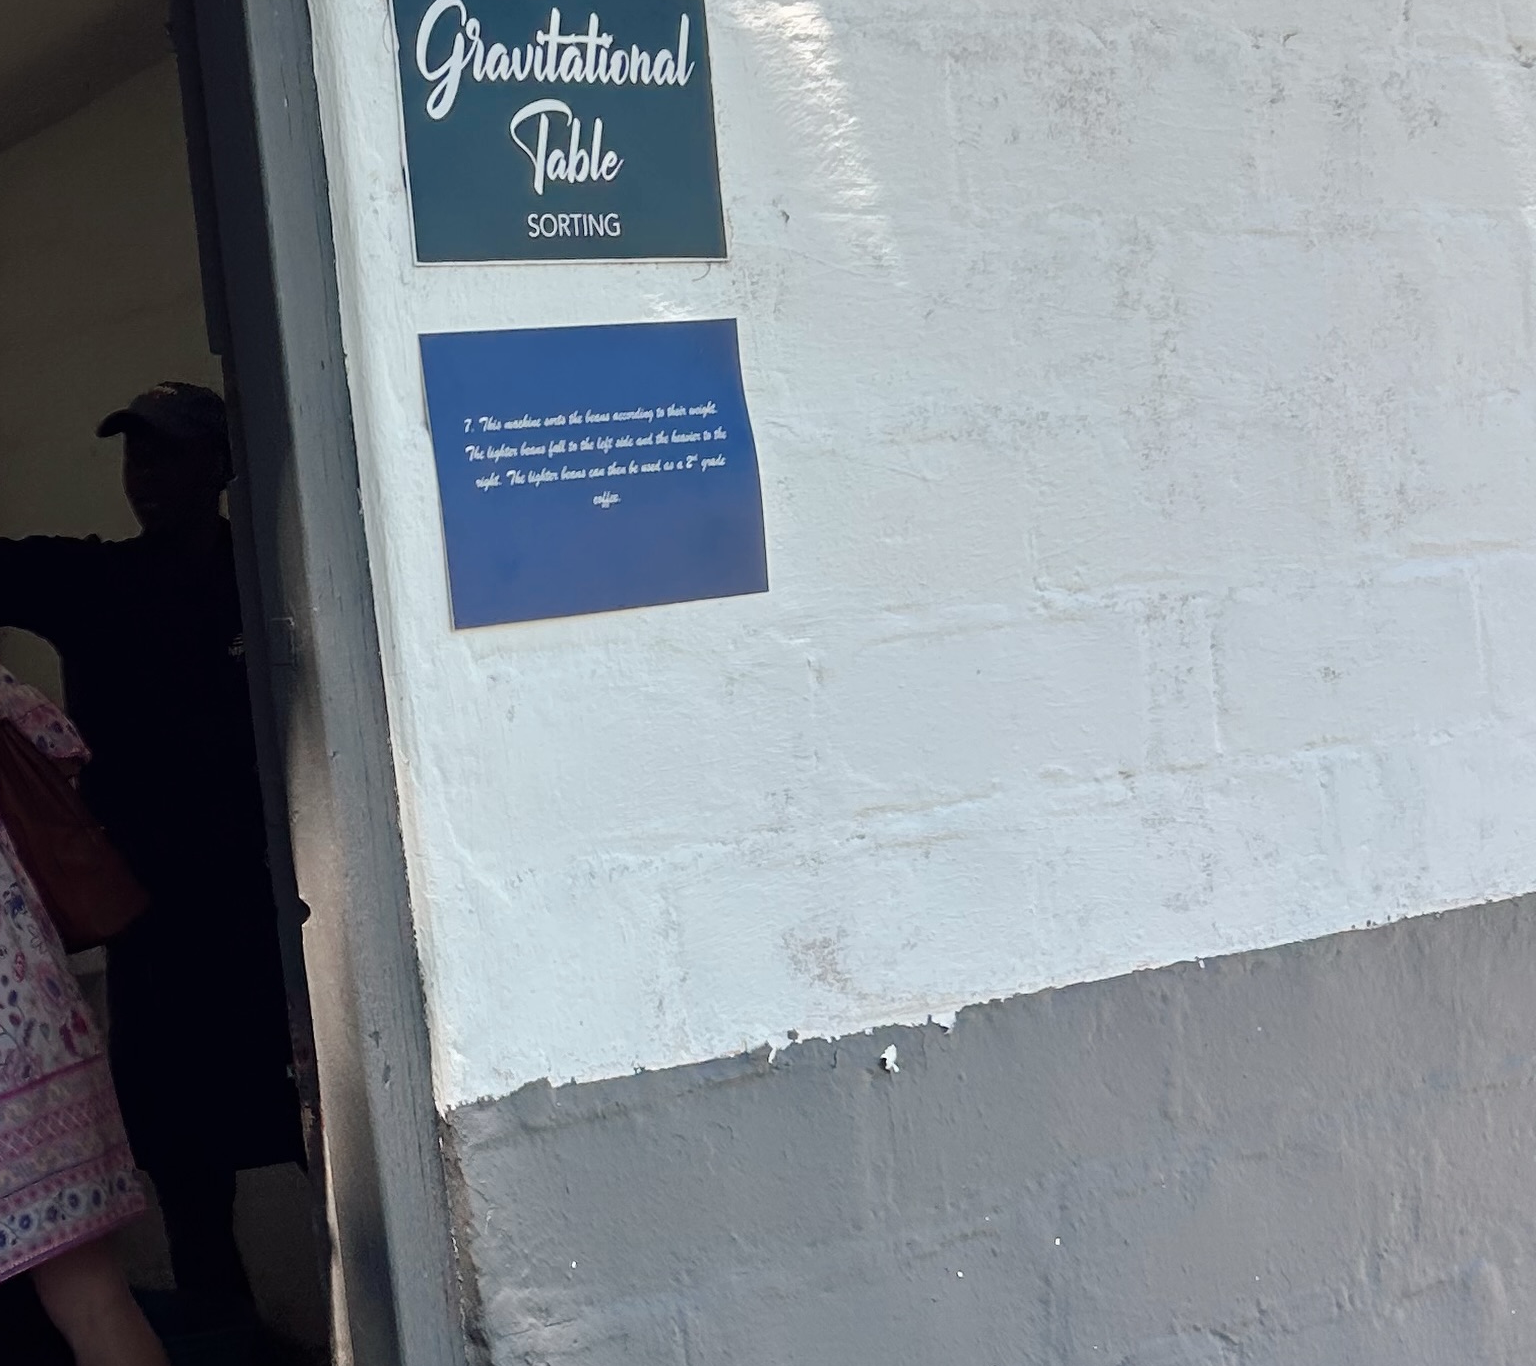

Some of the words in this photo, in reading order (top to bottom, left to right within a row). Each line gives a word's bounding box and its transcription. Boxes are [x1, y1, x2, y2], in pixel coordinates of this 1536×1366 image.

[510, 99, 624, 195] Table
[528, 213, 621, 238] SORTING
[479, 416, 502, 432] This
[504, 414, 541, 430] machine
[544, 415, 566, 427] sorts
[569, 410, 583, 425] the
[585, 409, 610, 423] beans
[612, 407, 654, 423] according
[656, 407, 664, 418] to
[667, 403, 686, 417] their
[465, 445, 485, 462] The
[487, 443, 518, 464] lighter
[520, 441, 546, 456] beans
[548, 439, 566, 458] fall
[568, 441, 578, 452] to
[580, 436, 595, 451] the
[597, 436, 614, 454] left
[615, 435, 634, 448] side
[635, 433, 653, 446] and
[655, 430, 669, 445] the
[671, 429, 701, 443] heavier
[703, 430, 712, 441] to
[714, 425, 727, 440] the
[506, 470, 526, 486] The
[527, 468, 559, 487] lighter
[561, 465, 586, 481] beans
[588, 468, 605, 478] can
[607, 461, 627, 476] then
[628, 460, 639, 474] be
[641, 459, 661, 472] used
[663, 461, 675, 471] as
[676, 461, 684, 470] a
[701, 453, 726, 472] grade
